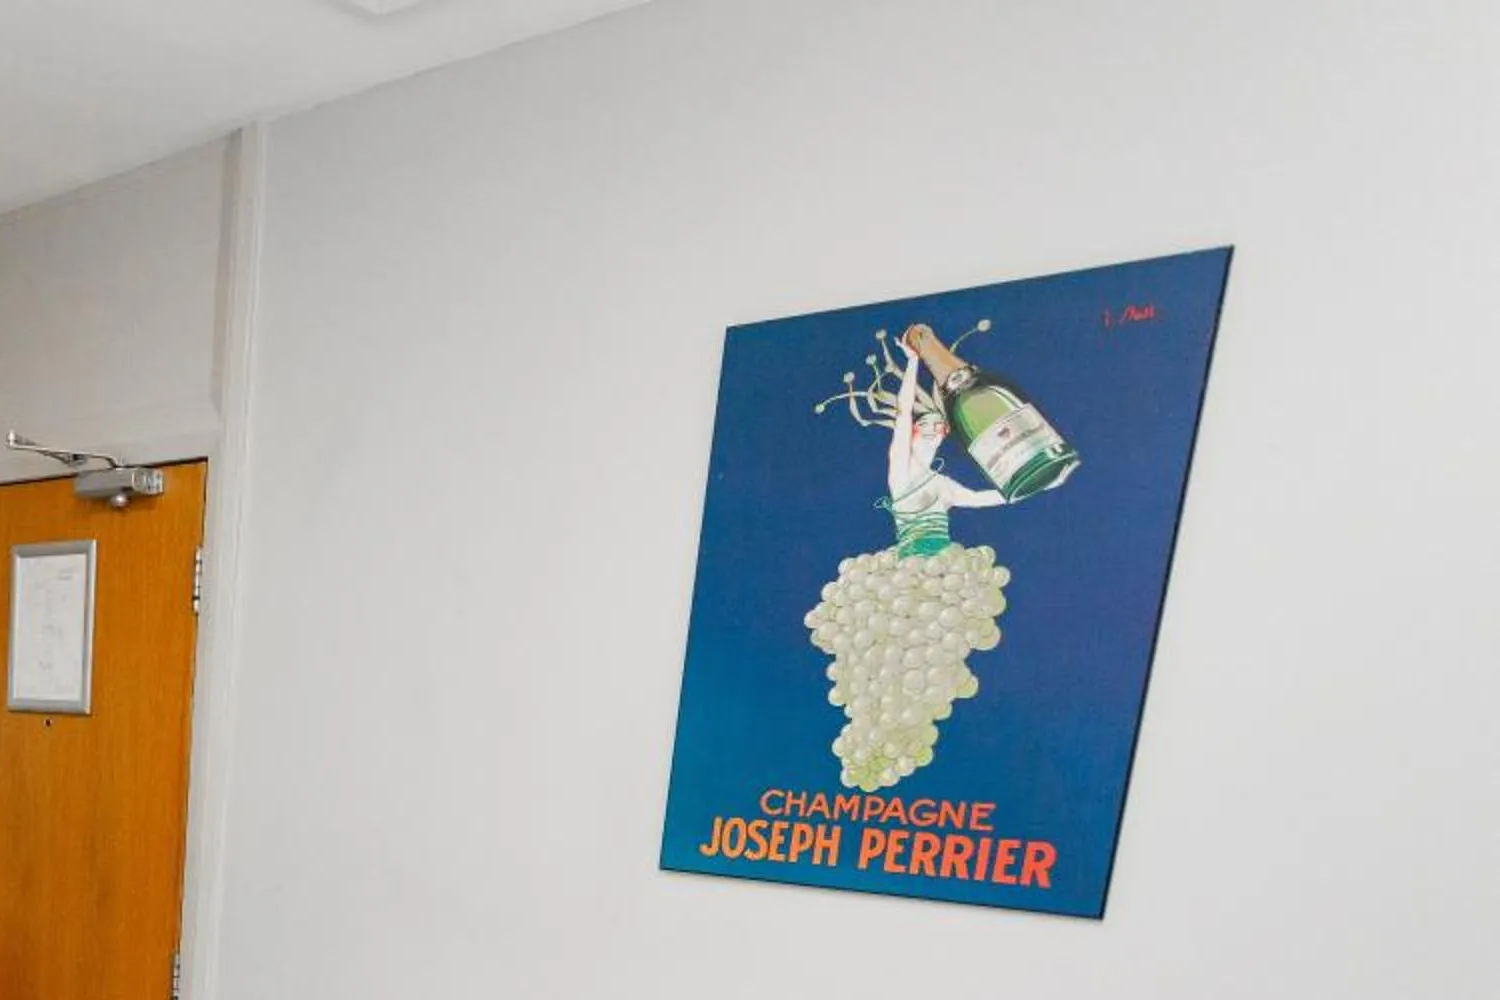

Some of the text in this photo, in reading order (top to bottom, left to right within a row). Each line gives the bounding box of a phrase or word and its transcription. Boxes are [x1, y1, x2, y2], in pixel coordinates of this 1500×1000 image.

[759, 789, 997, 832] CHAMPAGNE
[700, 816, 1058, 888] JOSEPH PERRIER
